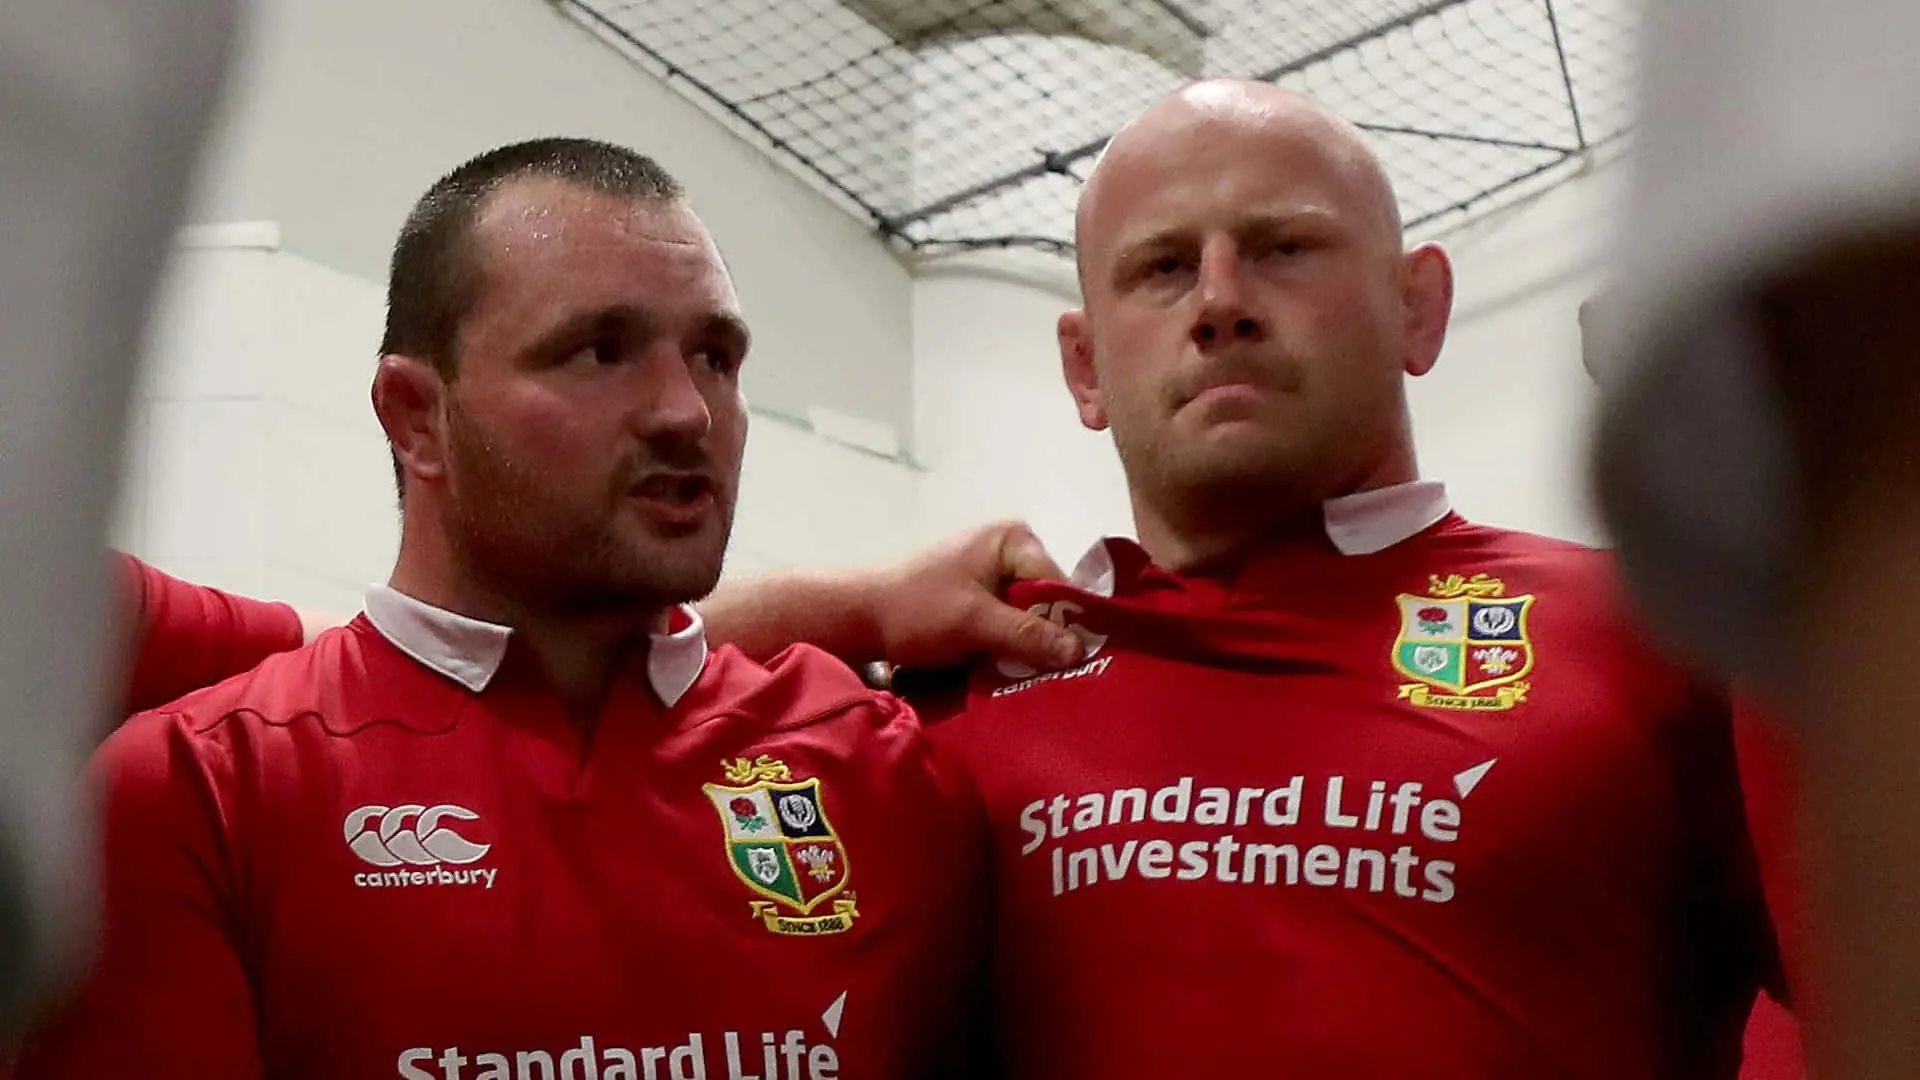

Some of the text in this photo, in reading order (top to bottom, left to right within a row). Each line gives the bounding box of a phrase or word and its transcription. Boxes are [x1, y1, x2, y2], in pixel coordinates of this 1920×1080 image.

[1019, 776, 1462, 855] Standard Life
[354, 865, 498, 889] canterbury
[1052, 835, 1456, 904] Investments
[397, 1030, 839, 1080] Standard Life
